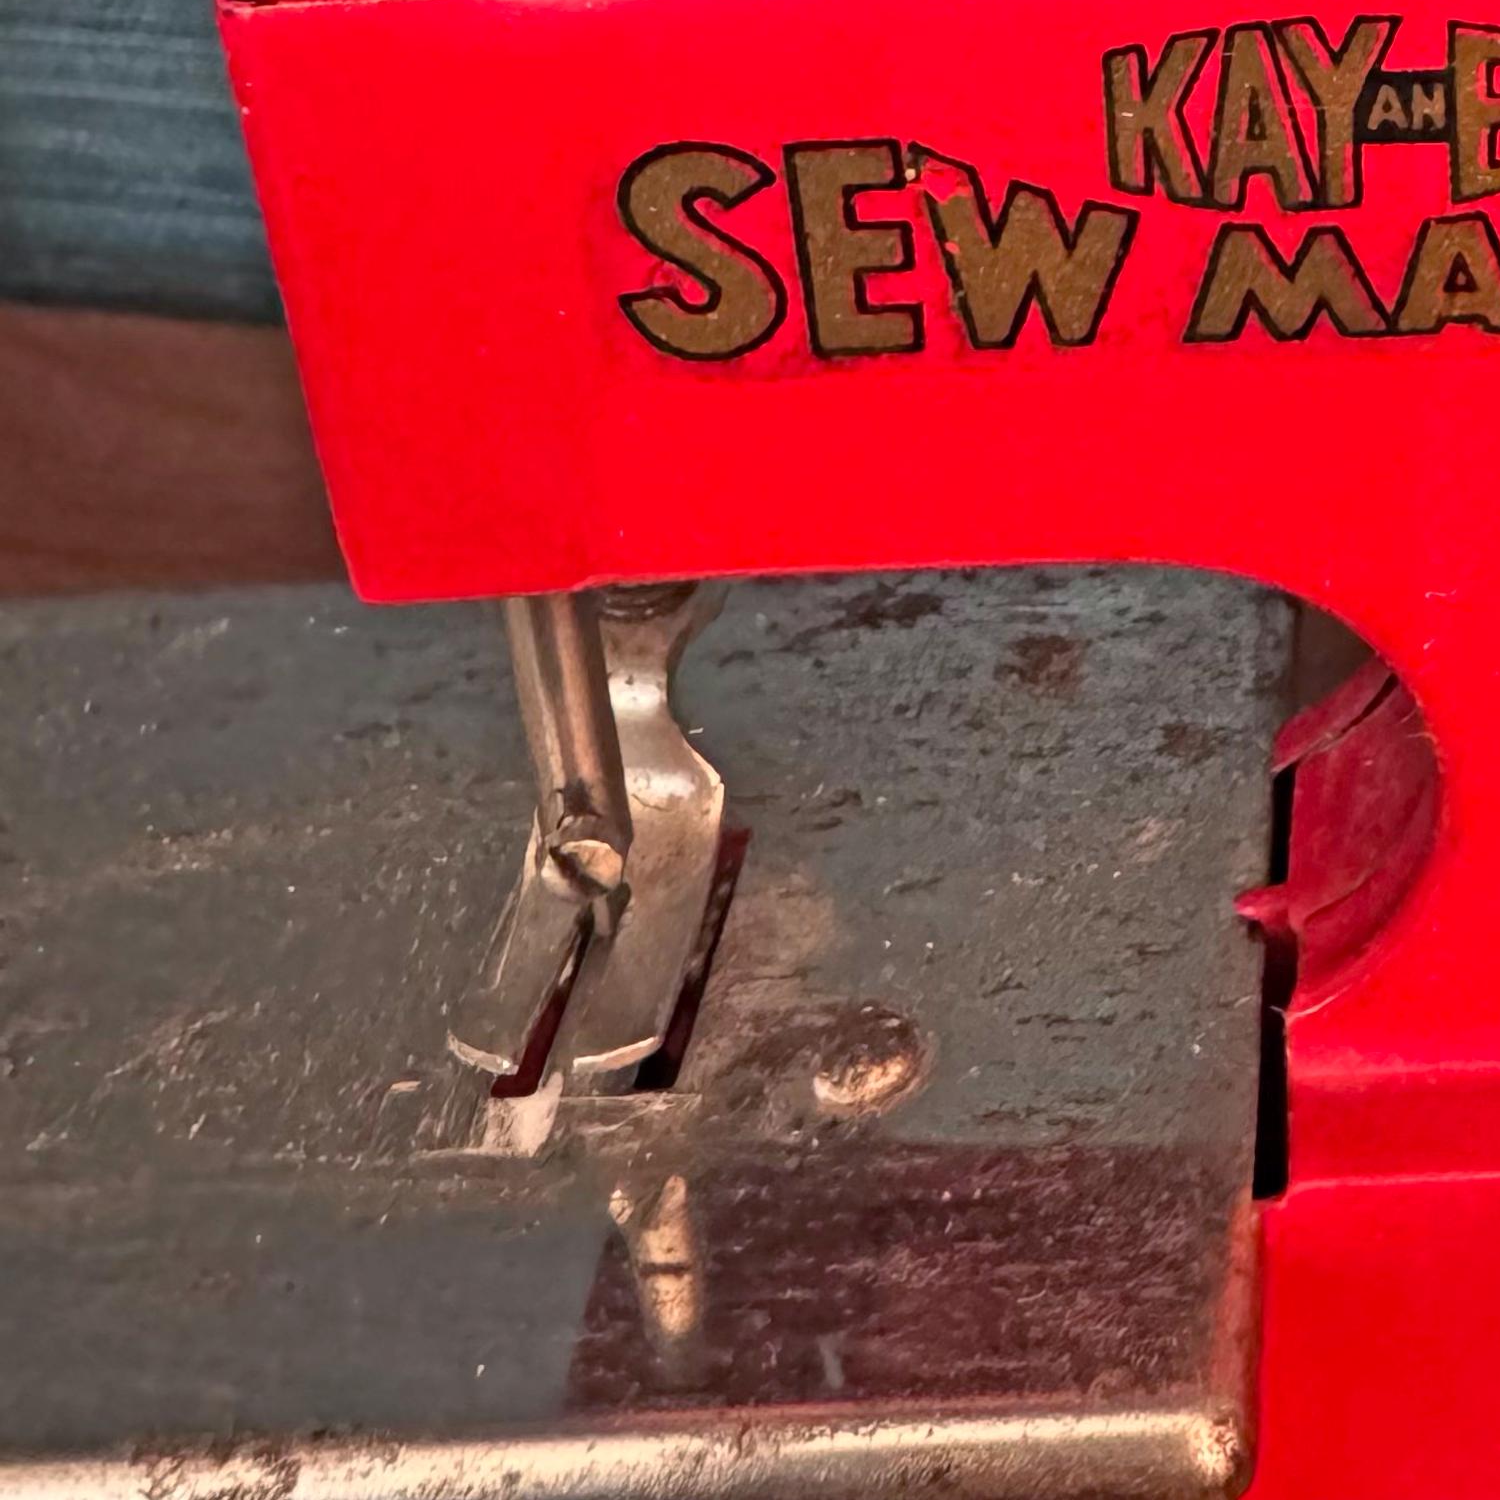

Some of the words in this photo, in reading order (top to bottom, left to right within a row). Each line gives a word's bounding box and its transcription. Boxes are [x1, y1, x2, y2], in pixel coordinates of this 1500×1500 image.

[1102, 14, 1403, 213] KAY
[1366, 82, 1447, 132] AN
[617, 138, 1140, 361] SEW
